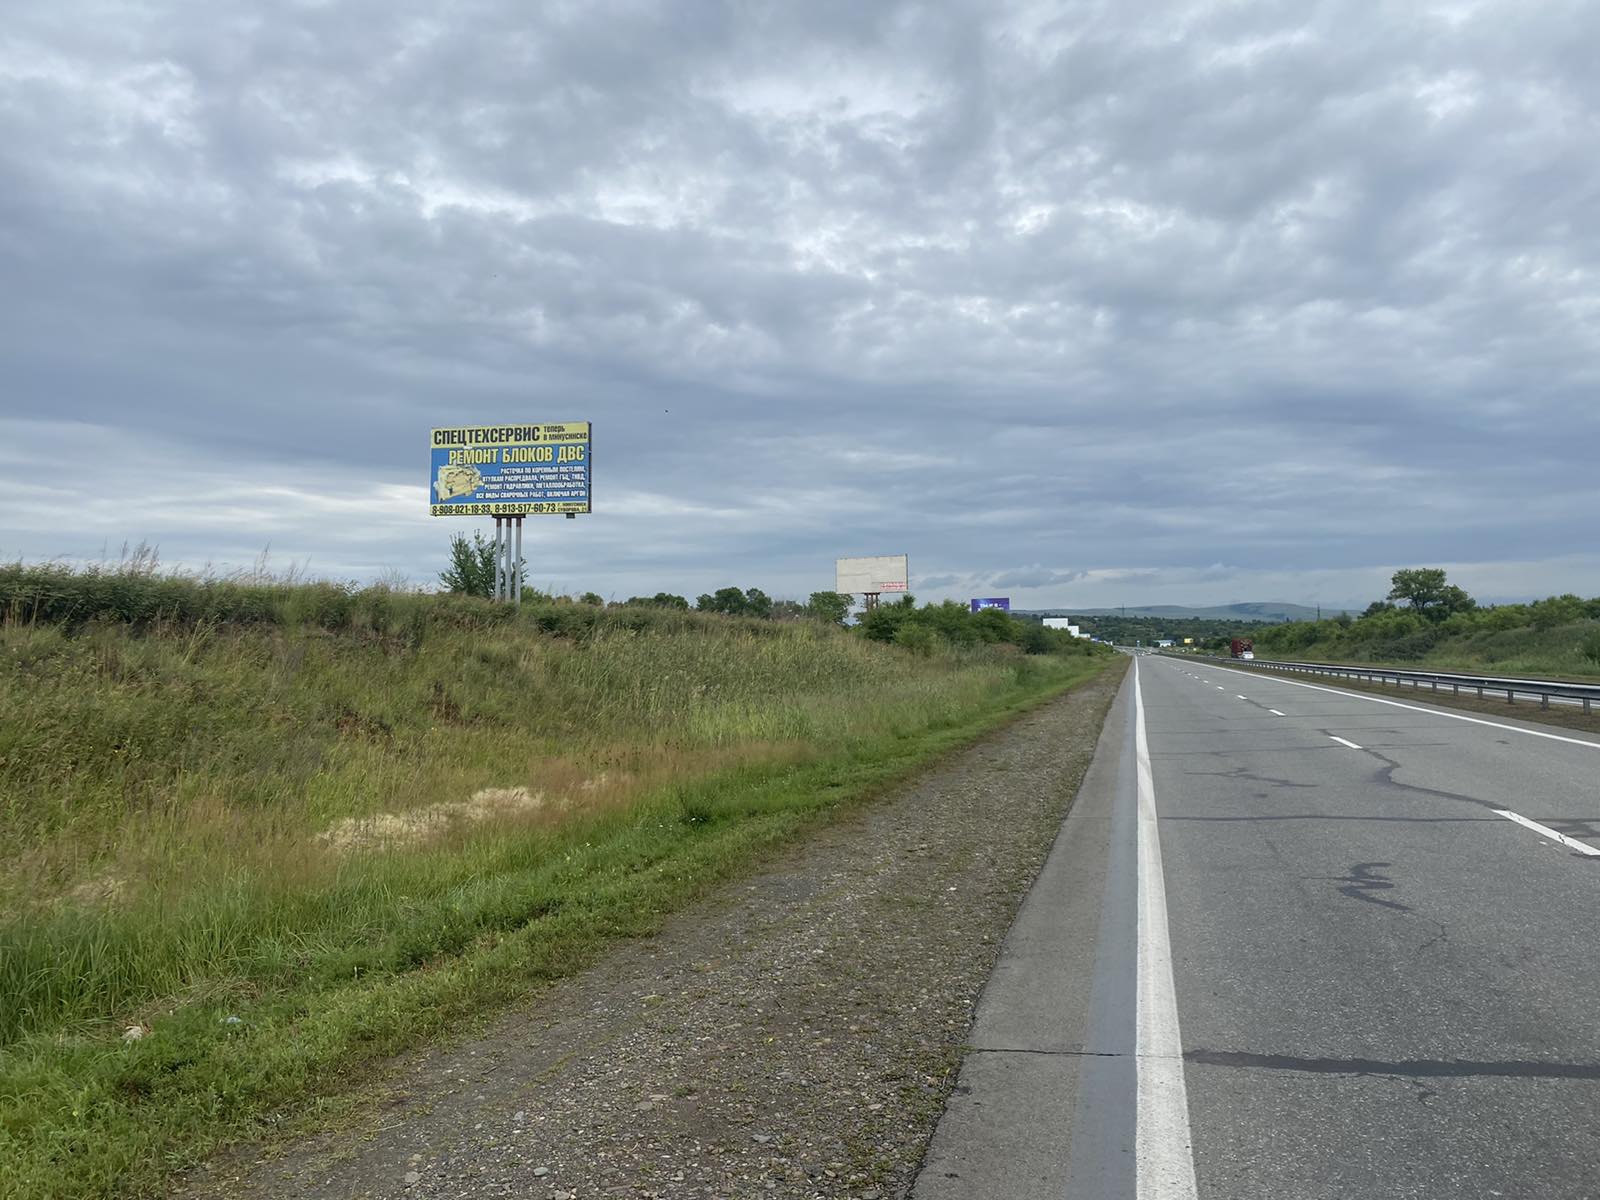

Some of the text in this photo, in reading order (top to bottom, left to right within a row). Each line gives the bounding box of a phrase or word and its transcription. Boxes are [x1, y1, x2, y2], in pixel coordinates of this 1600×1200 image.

[434, 427, 540, 446] СПЕЦТЕХСЕРВИС
[544, 425, 566, 434] теперь
[449, 445, 585, 465] РЕМОНТ БЛОКОВ ДВС
[432, 503, 556, 514] 8-908-021-18-33, 8-913-517-60-73
